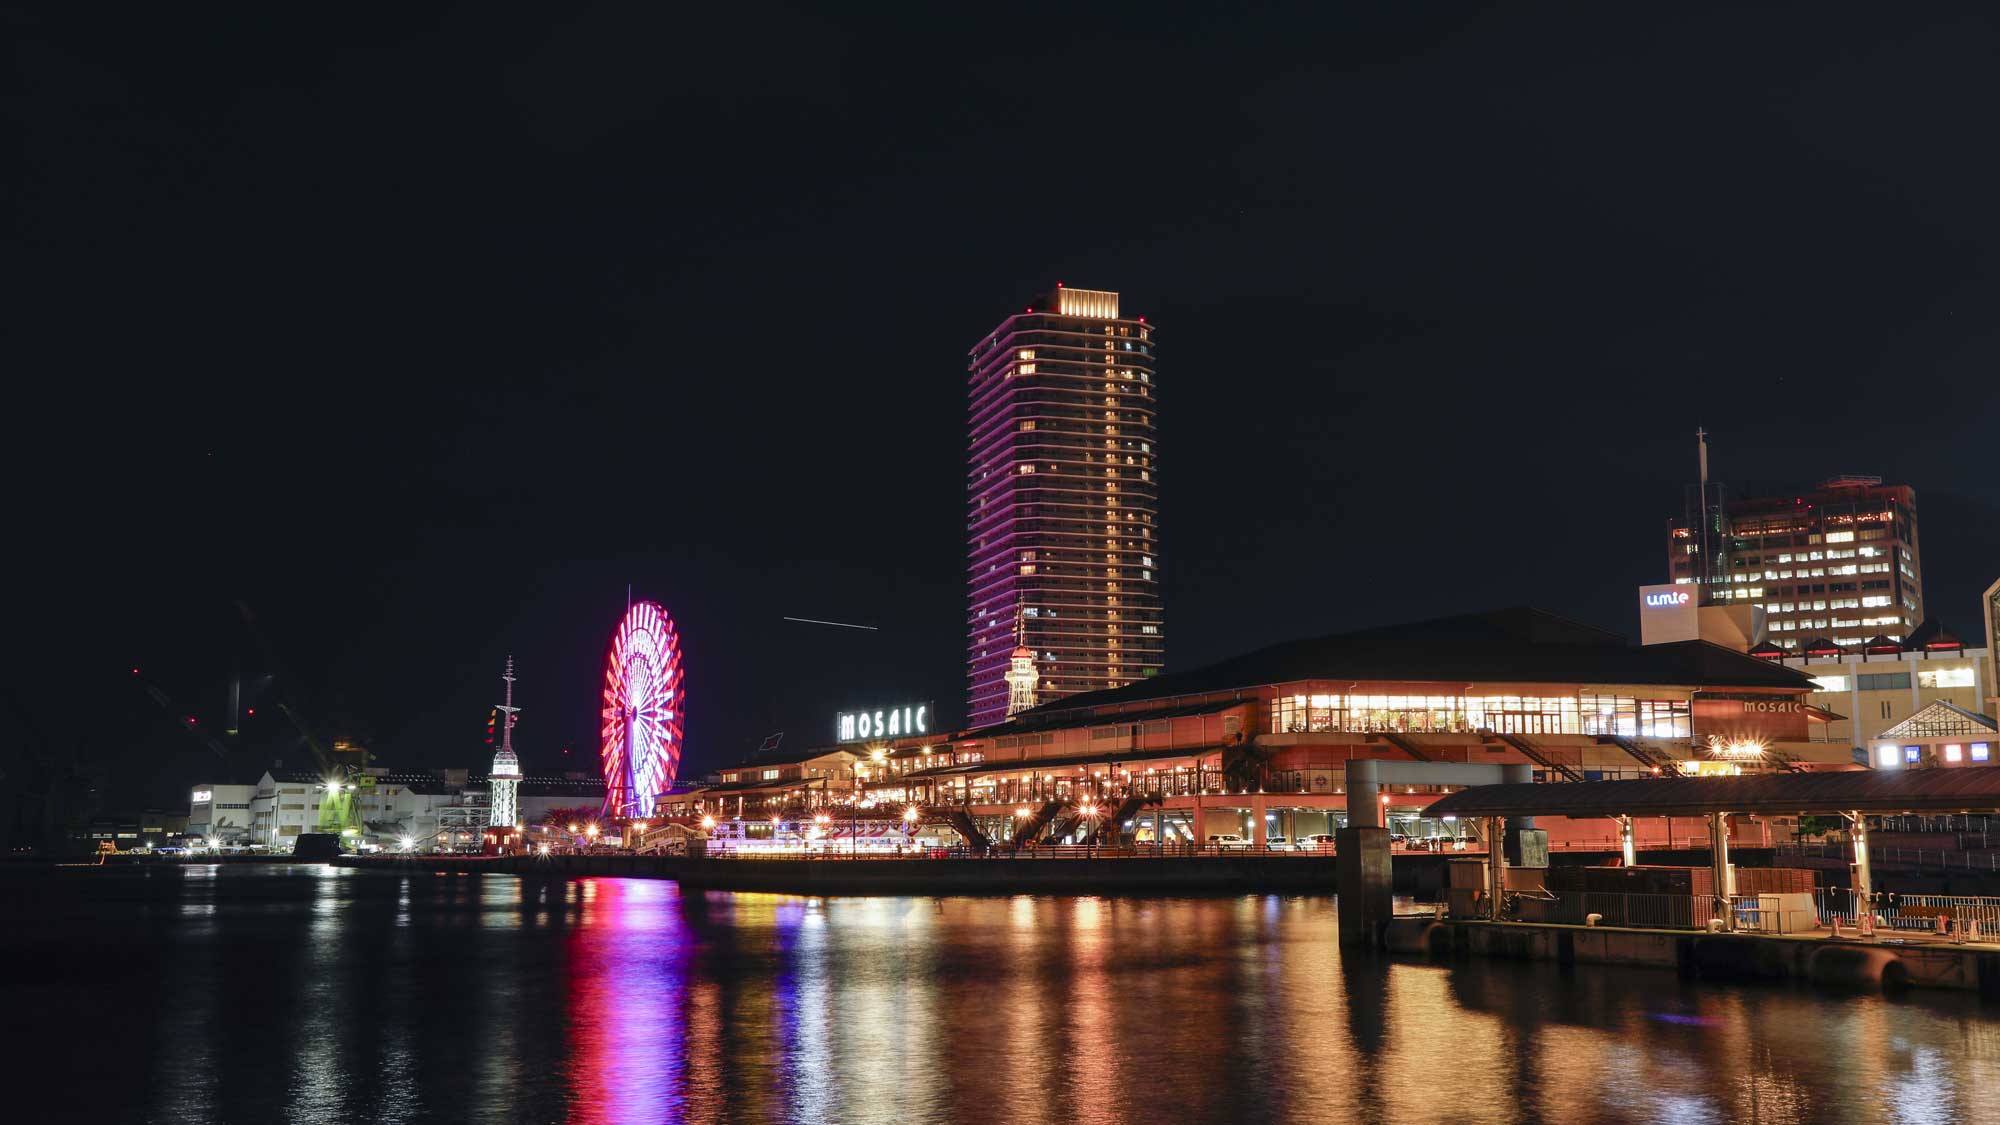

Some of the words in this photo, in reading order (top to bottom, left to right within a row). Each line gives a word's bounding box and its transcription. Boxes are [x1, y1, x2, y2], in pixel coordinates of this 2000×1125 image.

[1646, 591, 1689, 606] umie
[1744, 701, 1801, 714] MOSAIC
[841, 705, 926, 740] MOSAIC
